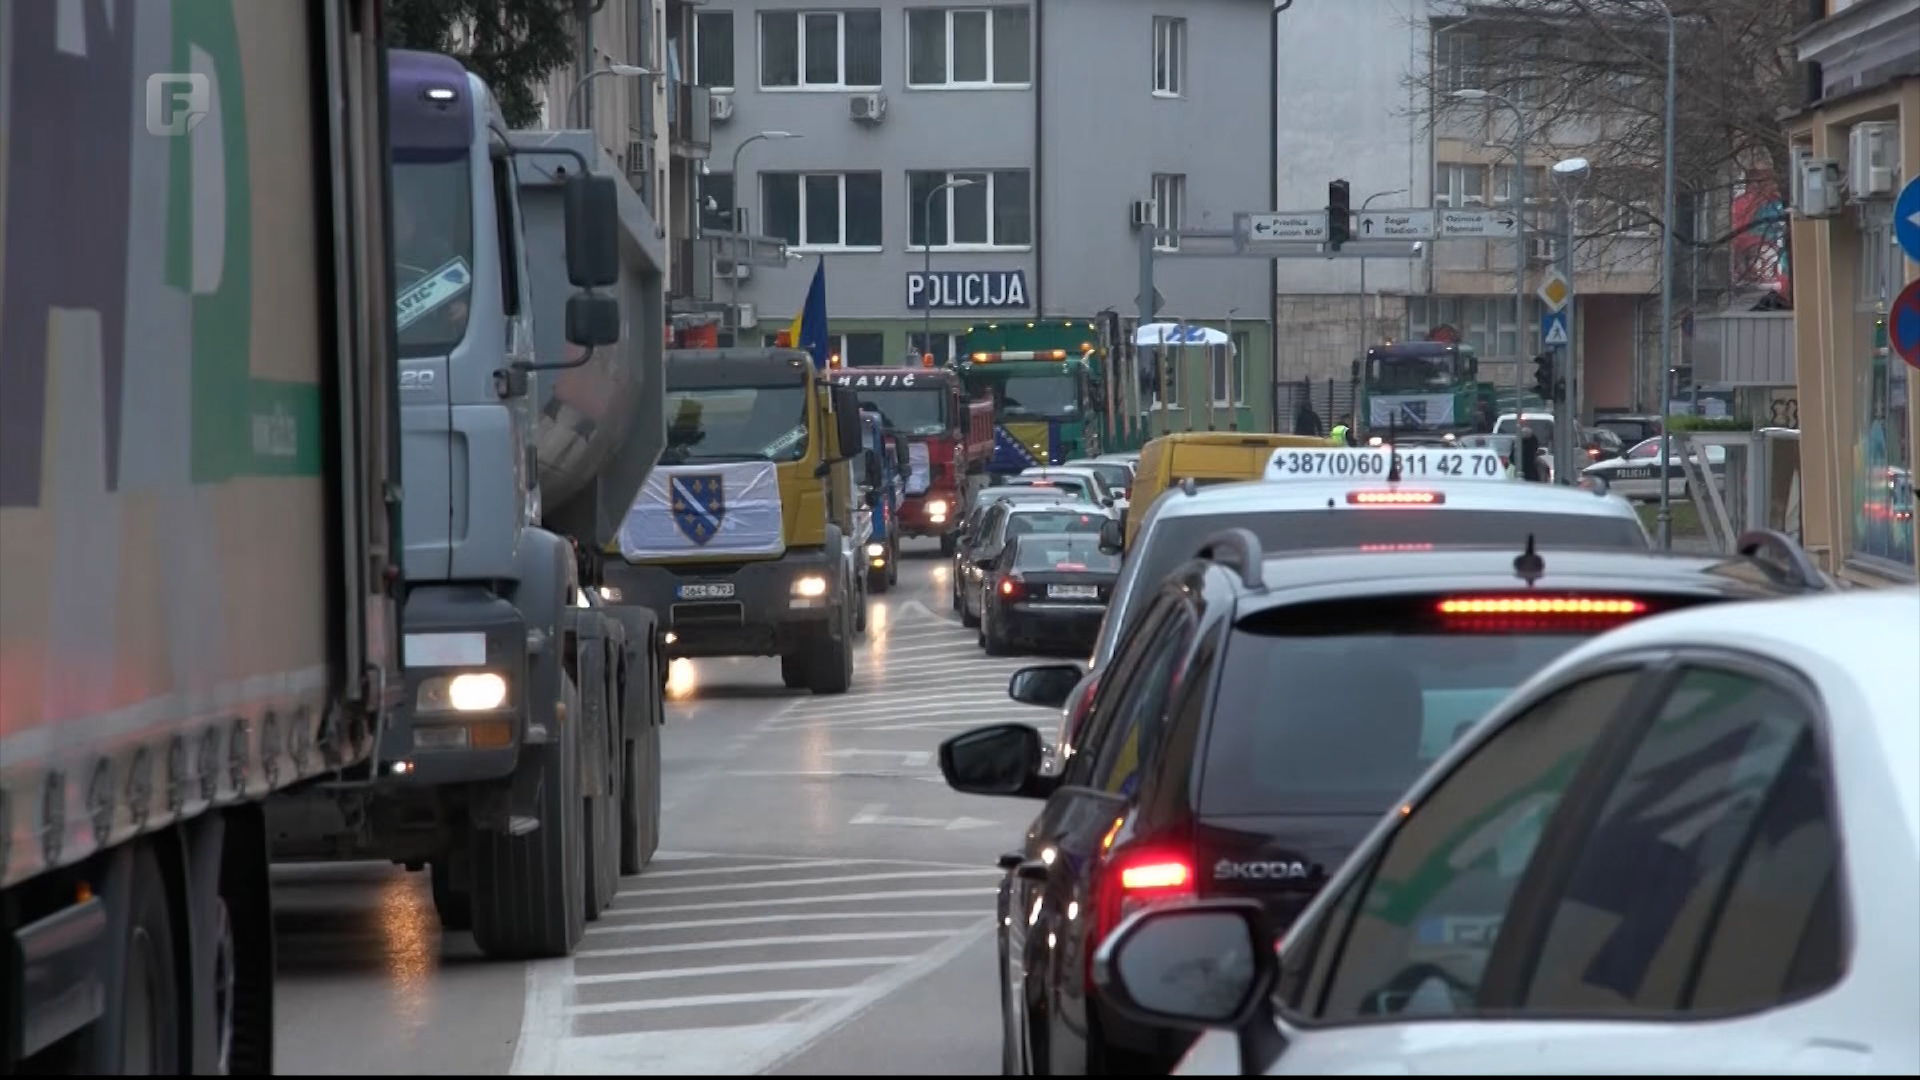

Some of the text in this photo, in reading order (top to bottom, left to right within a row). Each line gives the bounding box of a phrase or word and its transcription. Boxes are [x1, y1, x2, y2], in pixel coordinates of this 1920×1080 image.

[907, 273, 1025, 306] POLICIJA
[1273, 452, 1383, 475] +387(0)60
[1436, 454, 1463, 475] 42
[1471, 454, 1498, 475] 70
[1213, 857, 1308, 879] ŠKODA
